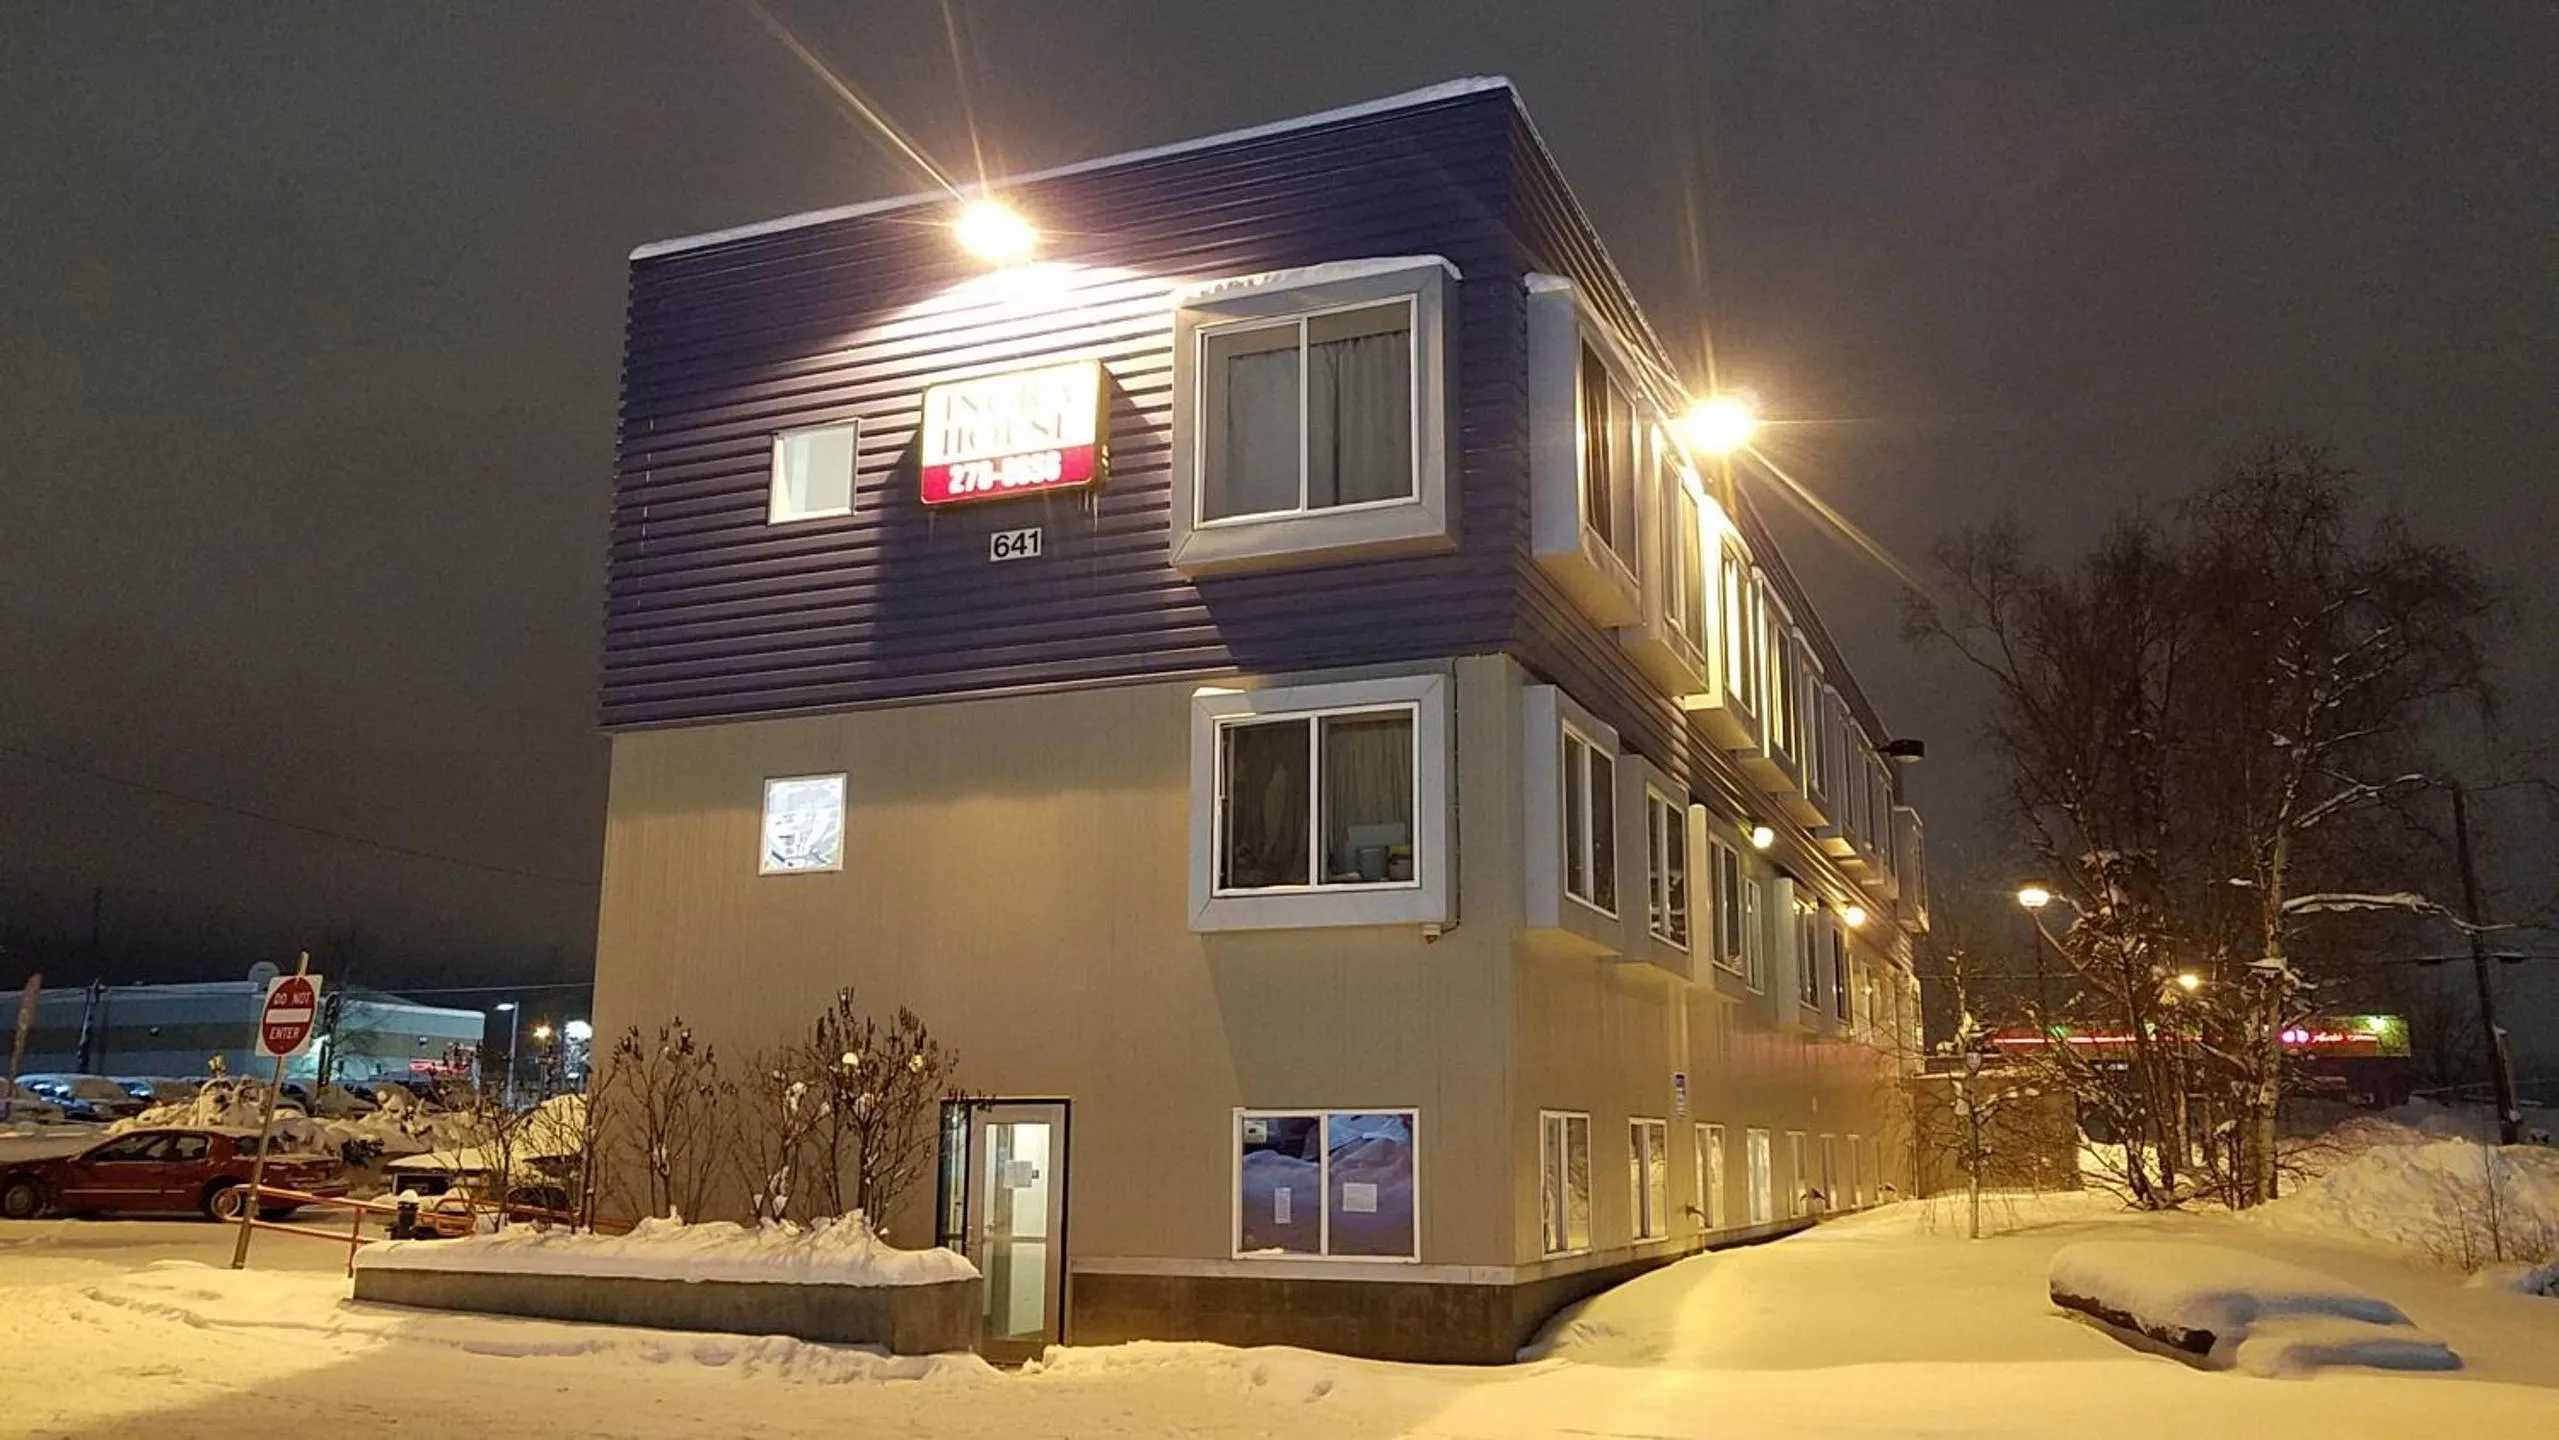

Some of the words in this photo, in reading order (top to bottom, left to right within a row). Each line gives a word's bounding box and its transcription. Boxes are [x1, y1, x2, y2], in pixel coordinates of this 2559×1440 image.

[993, 530, 1040, 558] 641
[273, 992, 288, 1006] DO
[291, 991, 312, 1006] NOT
[268, 1025, 301, 1040] ENTER
